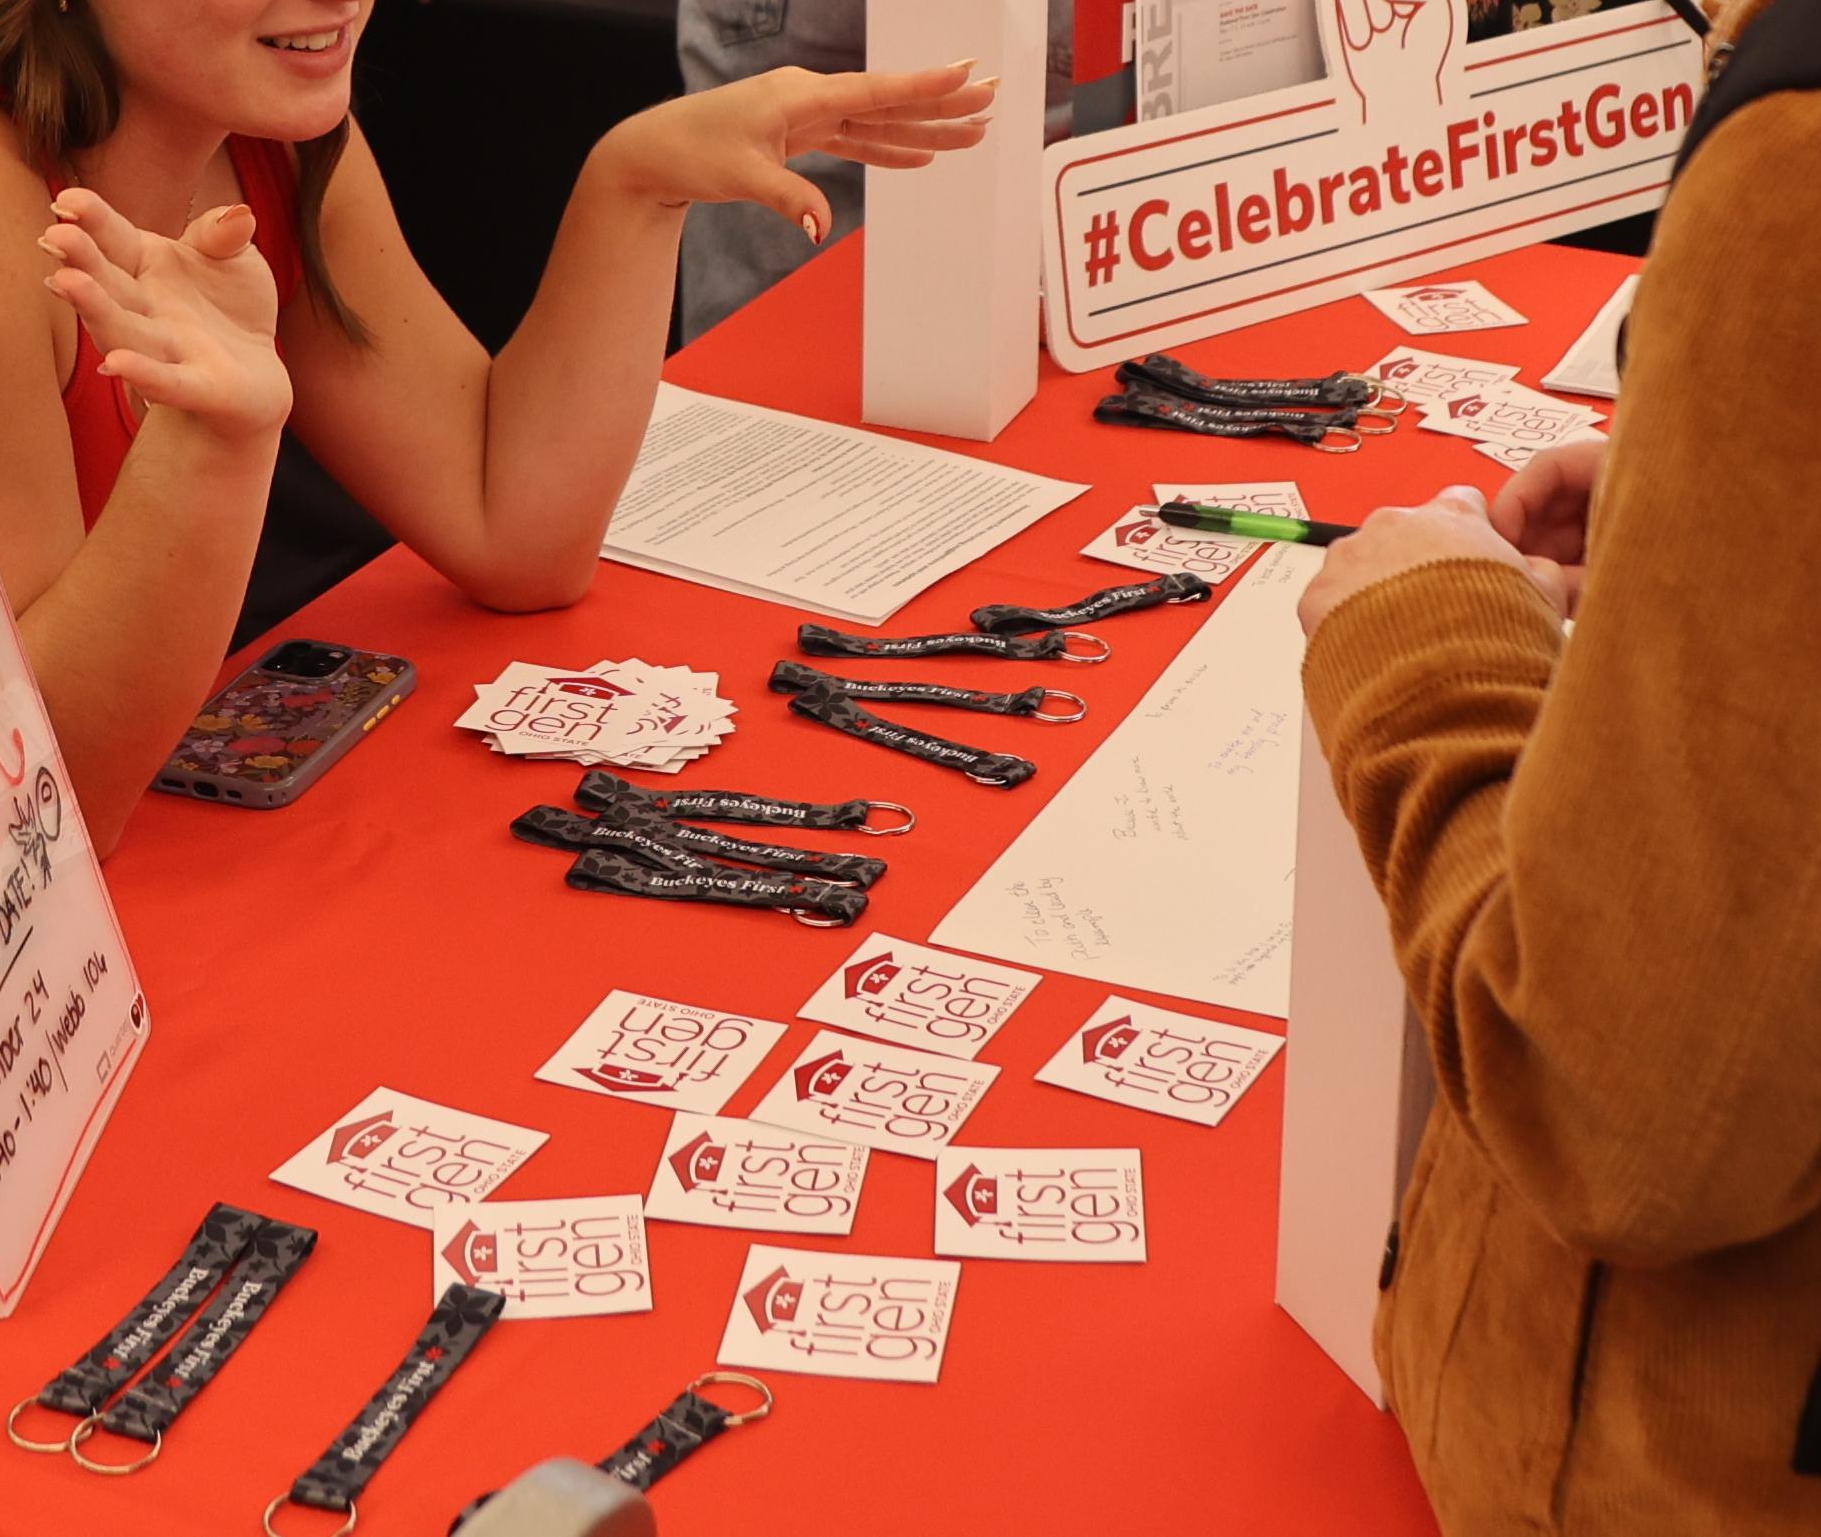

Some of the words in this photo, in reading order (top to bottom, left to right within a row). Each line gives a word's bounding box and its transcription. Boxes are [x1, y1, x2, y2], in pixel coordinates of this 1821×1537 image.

[1085, 80, 1694, 288] #CelebrateFirstGen
[1112, 586, 1146, 603] First
[883, 639, 923, 651] First
[925, 636, 1006, 649] Buckeyes
[504, 686, 618, 725] first
[844, 681, 927, 696] Buckeyes
[929, 687, 970, 700] First
[484, 708, 603, 742] gen
[519, 731, 550, 740] OHIO
[552, 736, 589, 747] STATE
[906, 735, 978, 763] Buckeyes
[673, 797, 716, 809] First
[719, 798, 806, 819] Buckeyes
[593, 826, 671, 858] Buckeyes
[672, 853, 703, 871] Fir
[676, 829, 760, 854] Buckeyes
[759, 846, 805, 863] First
[650, 874, 738, 892] Buckeyes
[741, 880, 786, 896] First
[24, 969, 50, 1025] 24
[636, 996, 676, 1013] STATE
[676, 1006, 717, 1022] OHIO
[864, 965, 966, 1030] first
[925, 976, 1011, 1043] gen
[986, 1003, 1011, 1026] OHIO
[1001, 983, 1027, 1011] STATE
[619, 1005, 756, 1054] gen
[596, 1030, 730, 1083] first
[1104, 1029, 1207, 1094] first
[1167, 1036, 1253, 1108] gen
[1229, 1070, 1253, 1091] OHIO
[1246, 1048, 1270, 1072] STATE
[819, 1062, 921, 1130] first
[884, 1070, 968, 1142] gen
[947, 1098, 969, 1123] OHIO
[963, 1078, 984, 1104] STATE
[343, 1124, 467, 1199] first
[404, 1137, 511, 1205] gen
[712, 1140, 796, 1212] first
[783, 1143, 851, 1218] gen
[1123, 1167, 1137, 1193] STATE
[998, 1167, 1066, 1245] first
[1070, 1168, 1140, 1245] gen
[1125, 1192, 1139, 1217] OHIO
[570, 1215, 645, 1299] gen
[143, 1265, 210, 1330] Buckeyes
[203, 1280, 263, 1349] Buckeyes
[789, 1274, 877, 1357] first
[935, 1280, 952, 1309] STATE
[865, 1280, 938, 1361] gen
[929, 1308, 945, 1335] OHIO
[113, 1329, 154, 1360] First
[173, 1343, 212, 1380] First
[341, 1391, 408, 1462] Buckeyes
[397, 1360, 436, 1395] First
